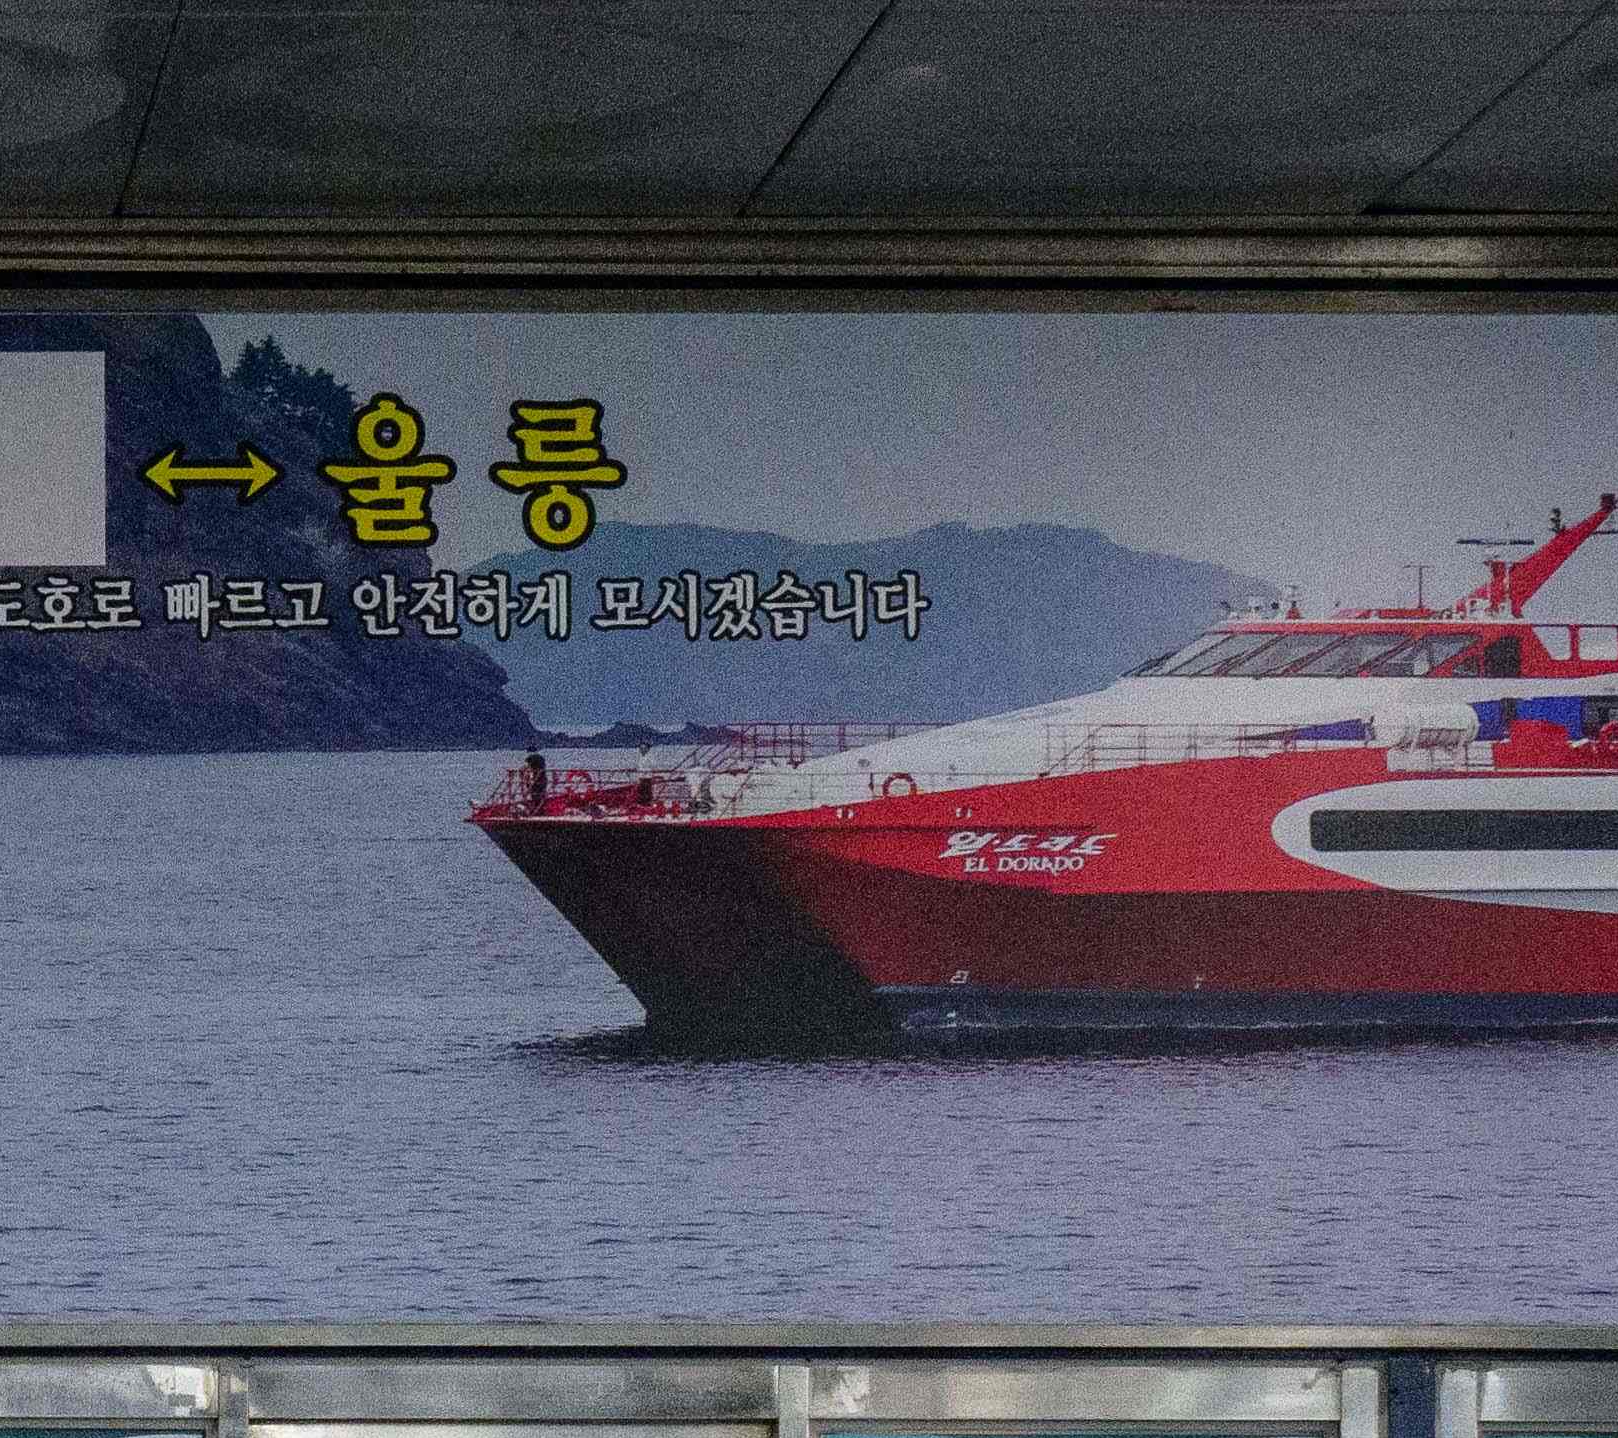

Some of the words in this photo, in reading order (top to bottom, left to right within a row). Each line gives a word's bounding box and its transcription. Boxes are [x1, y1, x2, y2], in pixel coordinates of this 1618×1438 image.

[165, 574, 328, 637] 빠르고
[351, 571, 572, 643] 안전하게
[593, 571, 932, 643] 모시겠습니다
[963, 857, 990, 873] EL
[997, 856, 1085, 874] DORADO
